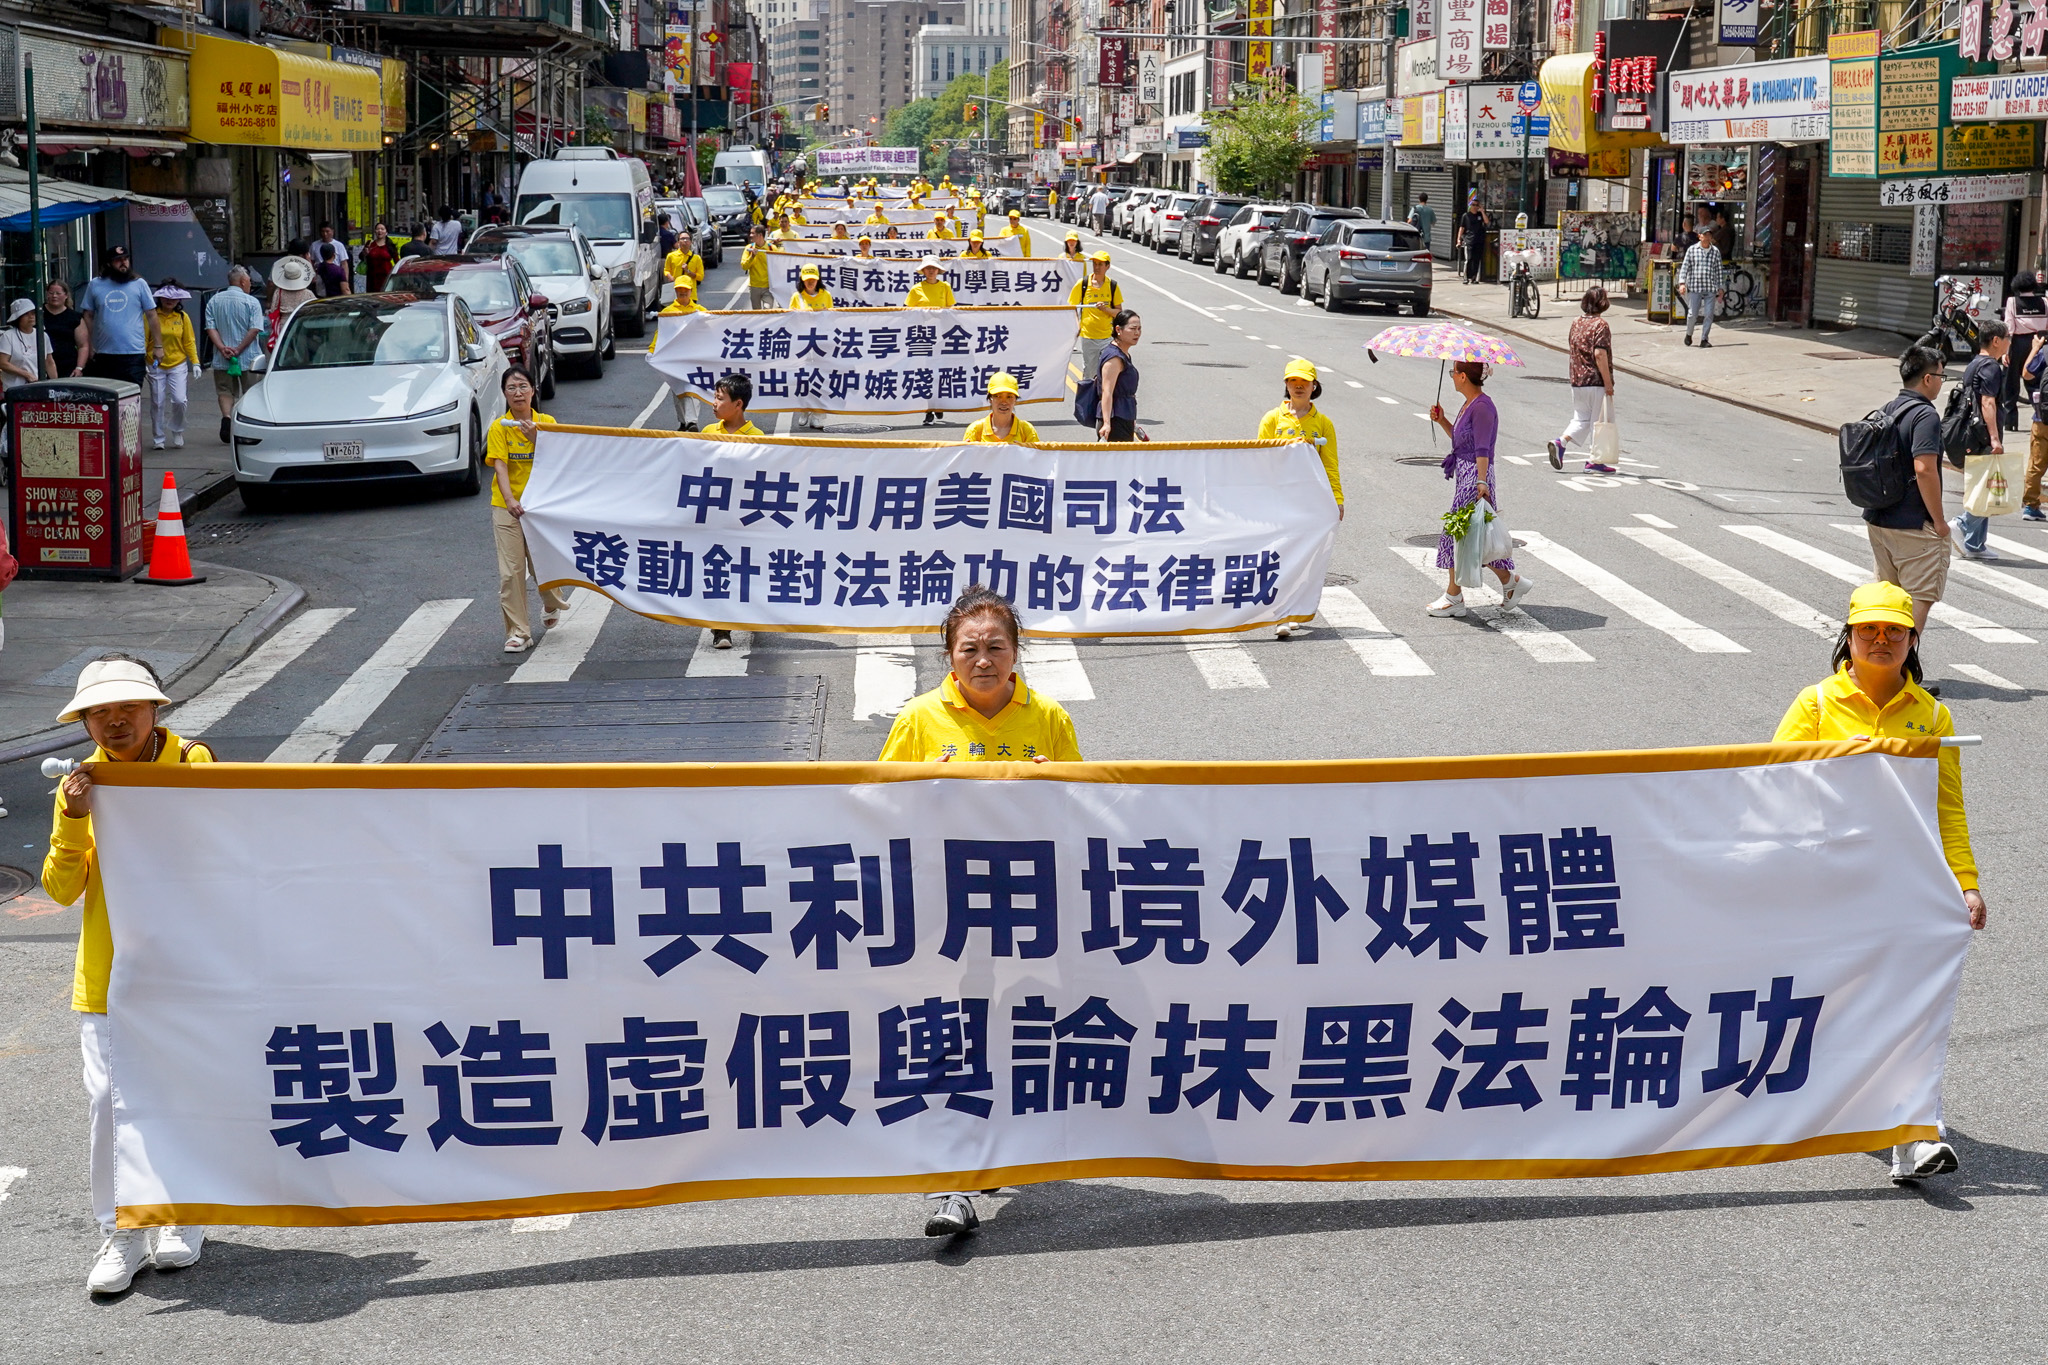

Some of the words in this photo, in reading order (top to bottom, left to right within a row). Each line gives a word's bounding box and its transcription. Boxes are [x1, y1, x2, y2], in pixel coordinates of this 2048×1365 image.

[1144, 54, 1156, 100] 大帝國
[1761, 78, 1802, 103] PHARMACY
[1803, 76, 1817, 101] INC
[1989, 79, 2012, 100] JUFU
[216, 102, 278, 116] 福州小吃店
[220, 117, 276, 128] 646-326-8810
[818, 151, 866, 165] 解體中共
[869, 150, 917, 164] 結束迫害
[721, 324, 1010, 361] 法輪大法享譽全球
[25, 487, 57, 500] SHOW
[677, 466, 1186, 535] 中共利用美國司法
[25, 501, 79, 525] LOVE
[44, 527, 80, 540] CLEAN
[572, 530, 1281, 612] 發動針對法輪功的法律戰
[942, 742, 1037, 760] 法輪大法
[490, 827, 1625, 980] 中共利用境外媒體
[266, 976, 1825, 1160] 製造虛假輿論抹黑法輪功
